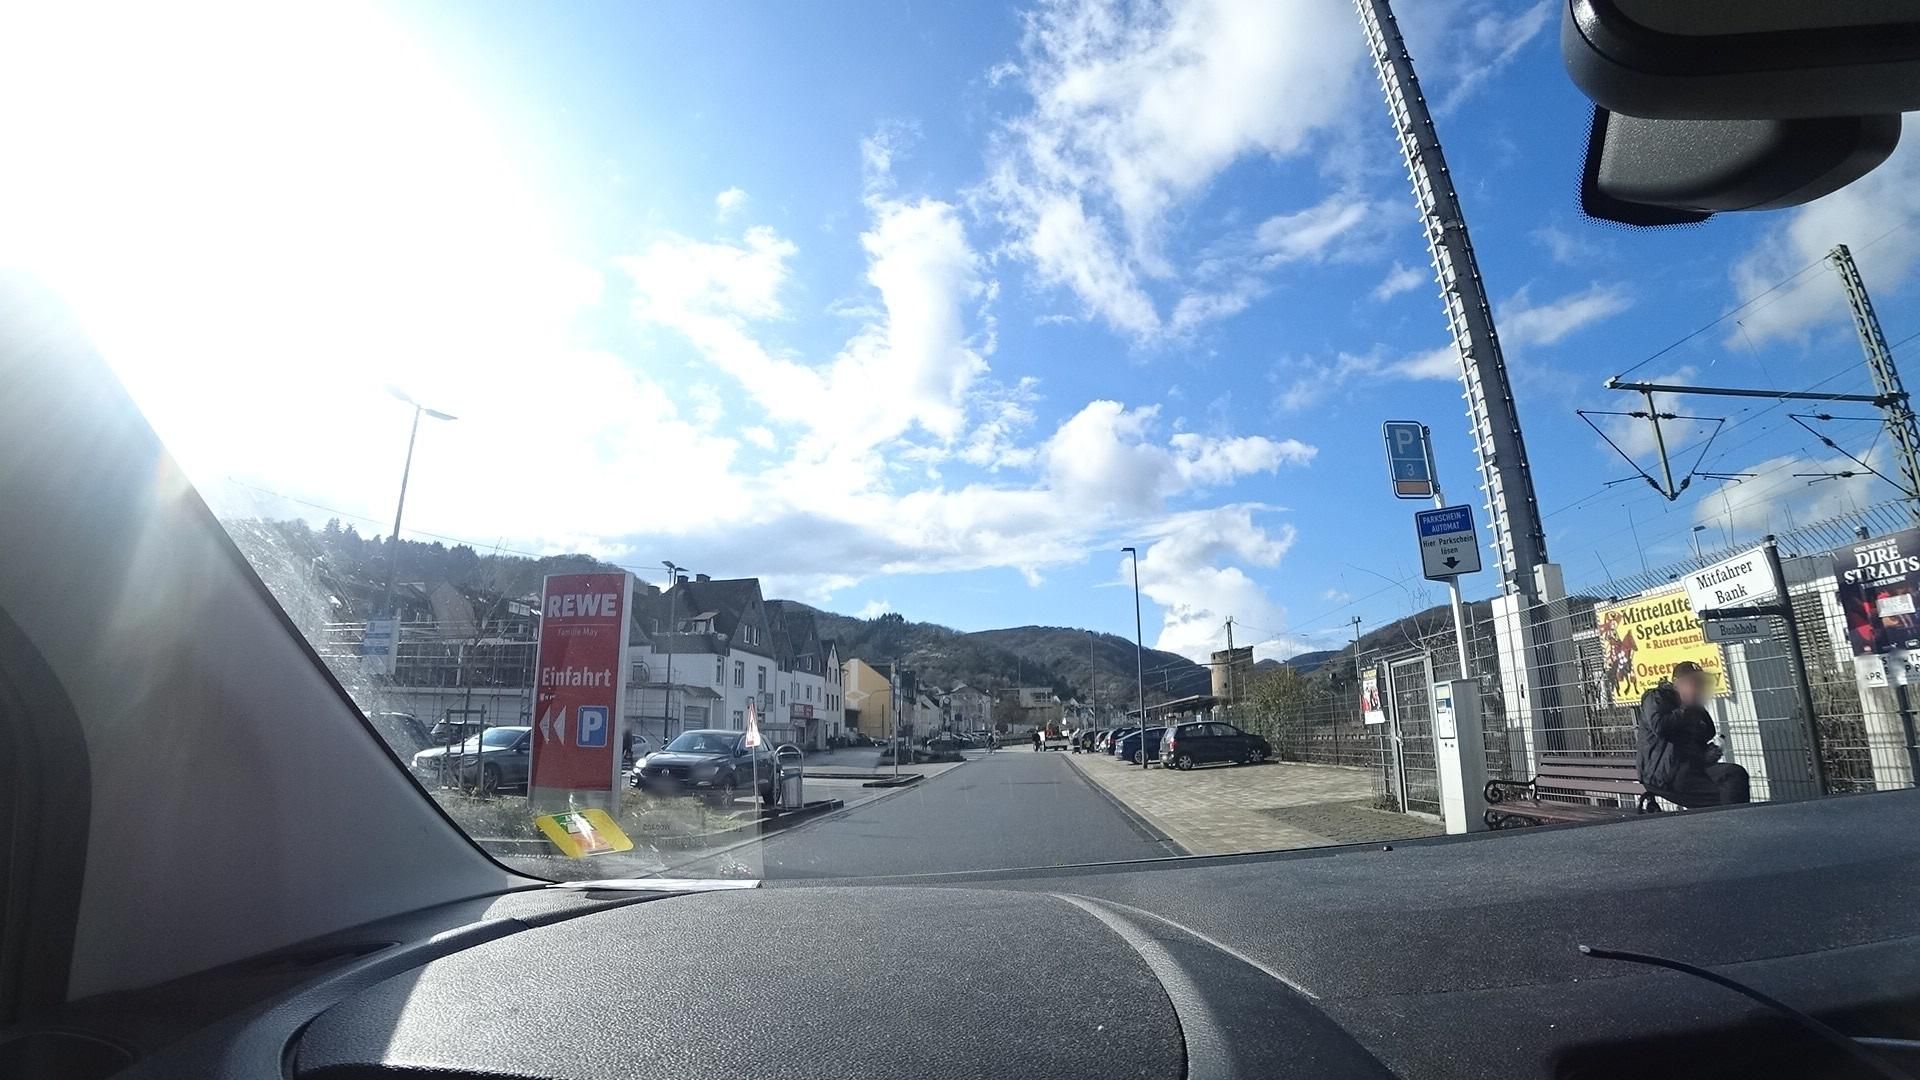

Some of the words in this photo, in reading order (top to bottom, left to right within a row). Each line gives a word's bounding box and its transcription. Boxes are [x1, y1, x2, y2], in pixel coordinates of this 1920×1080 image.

[1395, 428, 1413, 454] P
[1406, 463, 1415, 477] 3
[1422, 511, 1465, 524] PARKSCHEIN-
[1431, 521, 1460, 532] AUTOMAT
[1439, 535, 1474, 545] Parkschein
[1855, 545, 1901, 568] DIRE
[1696, 560, 1753, 590] Mitfahrer
[1844, 556, 1920, 585] STRAITS
[1714, 583, 1748, 604] Bank
[547, 593, 618, 618] REWE
[1622, 597, 1692, 625] Mittelalte
[583, 627, 598, 637] May
[1653, 632, 1703, 649] Ritterturni
[542, 666, 612, 687] Einfahrt
[581, 711, 603, 742] P
